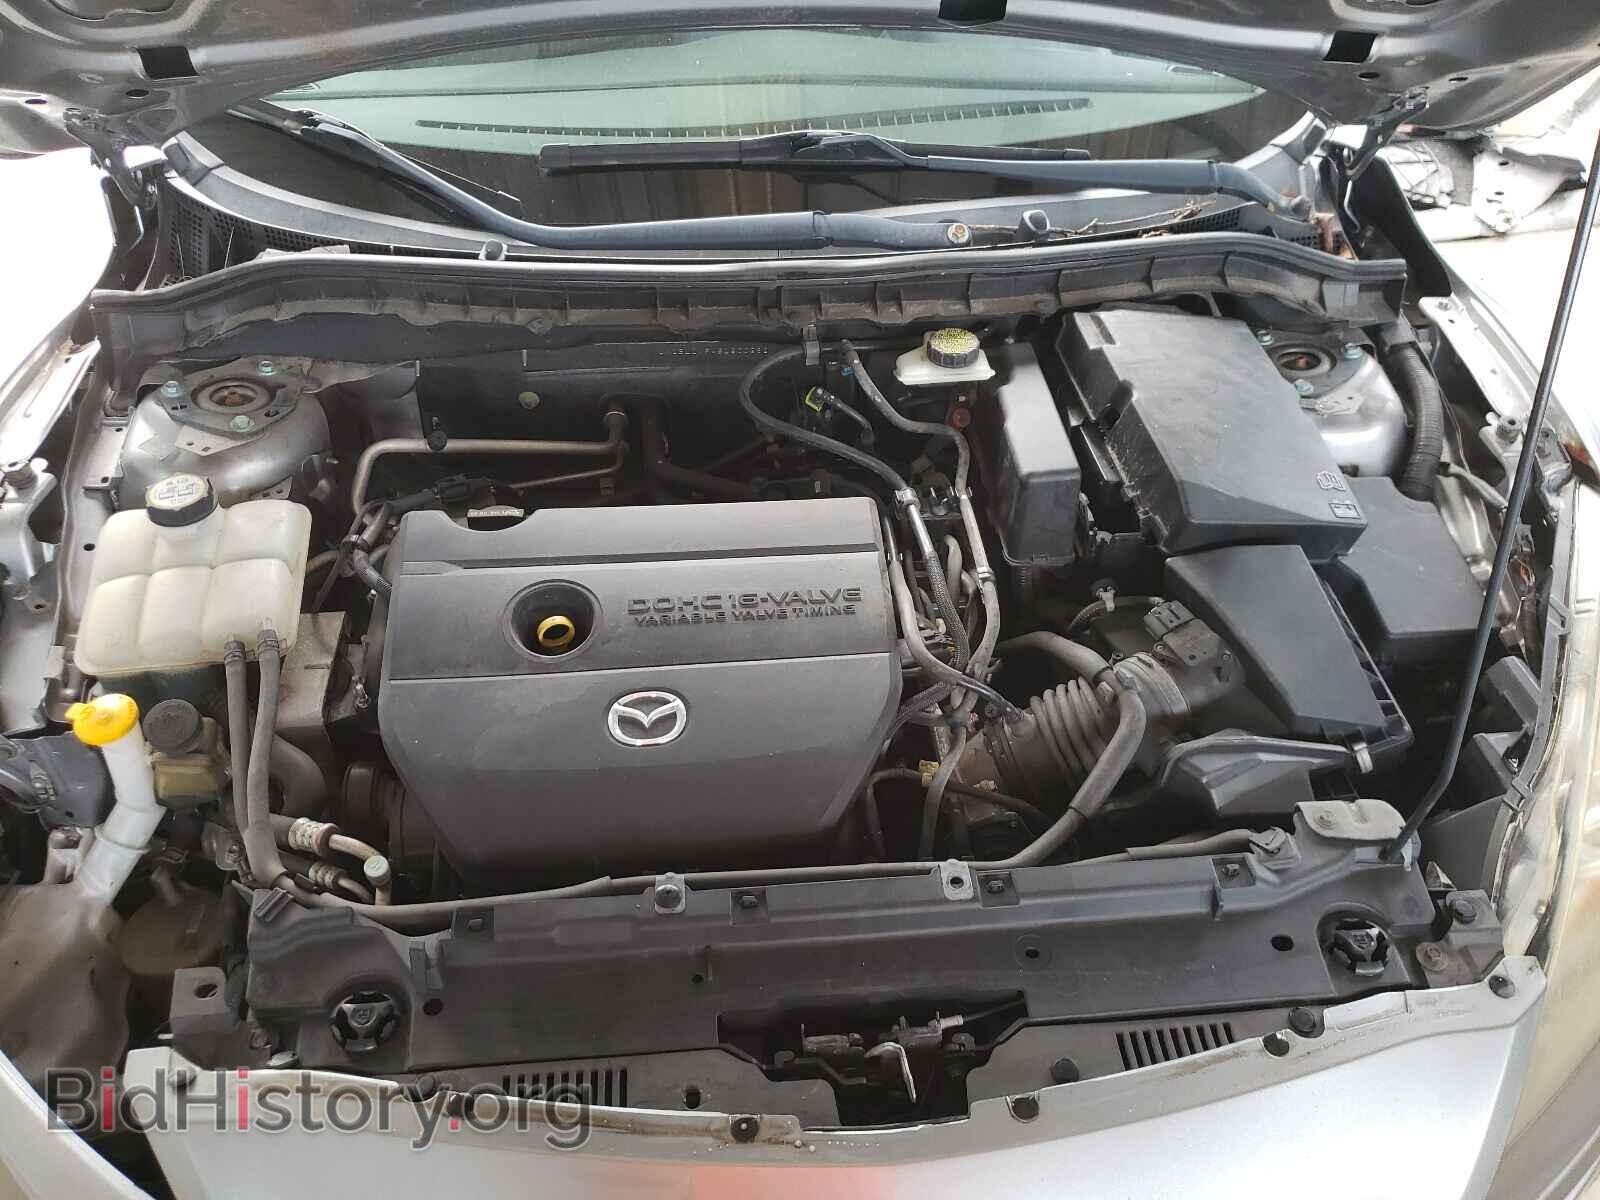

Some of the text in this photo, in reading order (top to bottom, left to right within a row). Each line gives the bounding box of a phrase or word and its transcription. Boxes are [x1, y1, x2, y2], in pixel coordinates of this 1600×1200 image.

[627, 593, 722, 615] DOHC
[634, 603, 857, 627] VARIABLE VALVE TIMING
